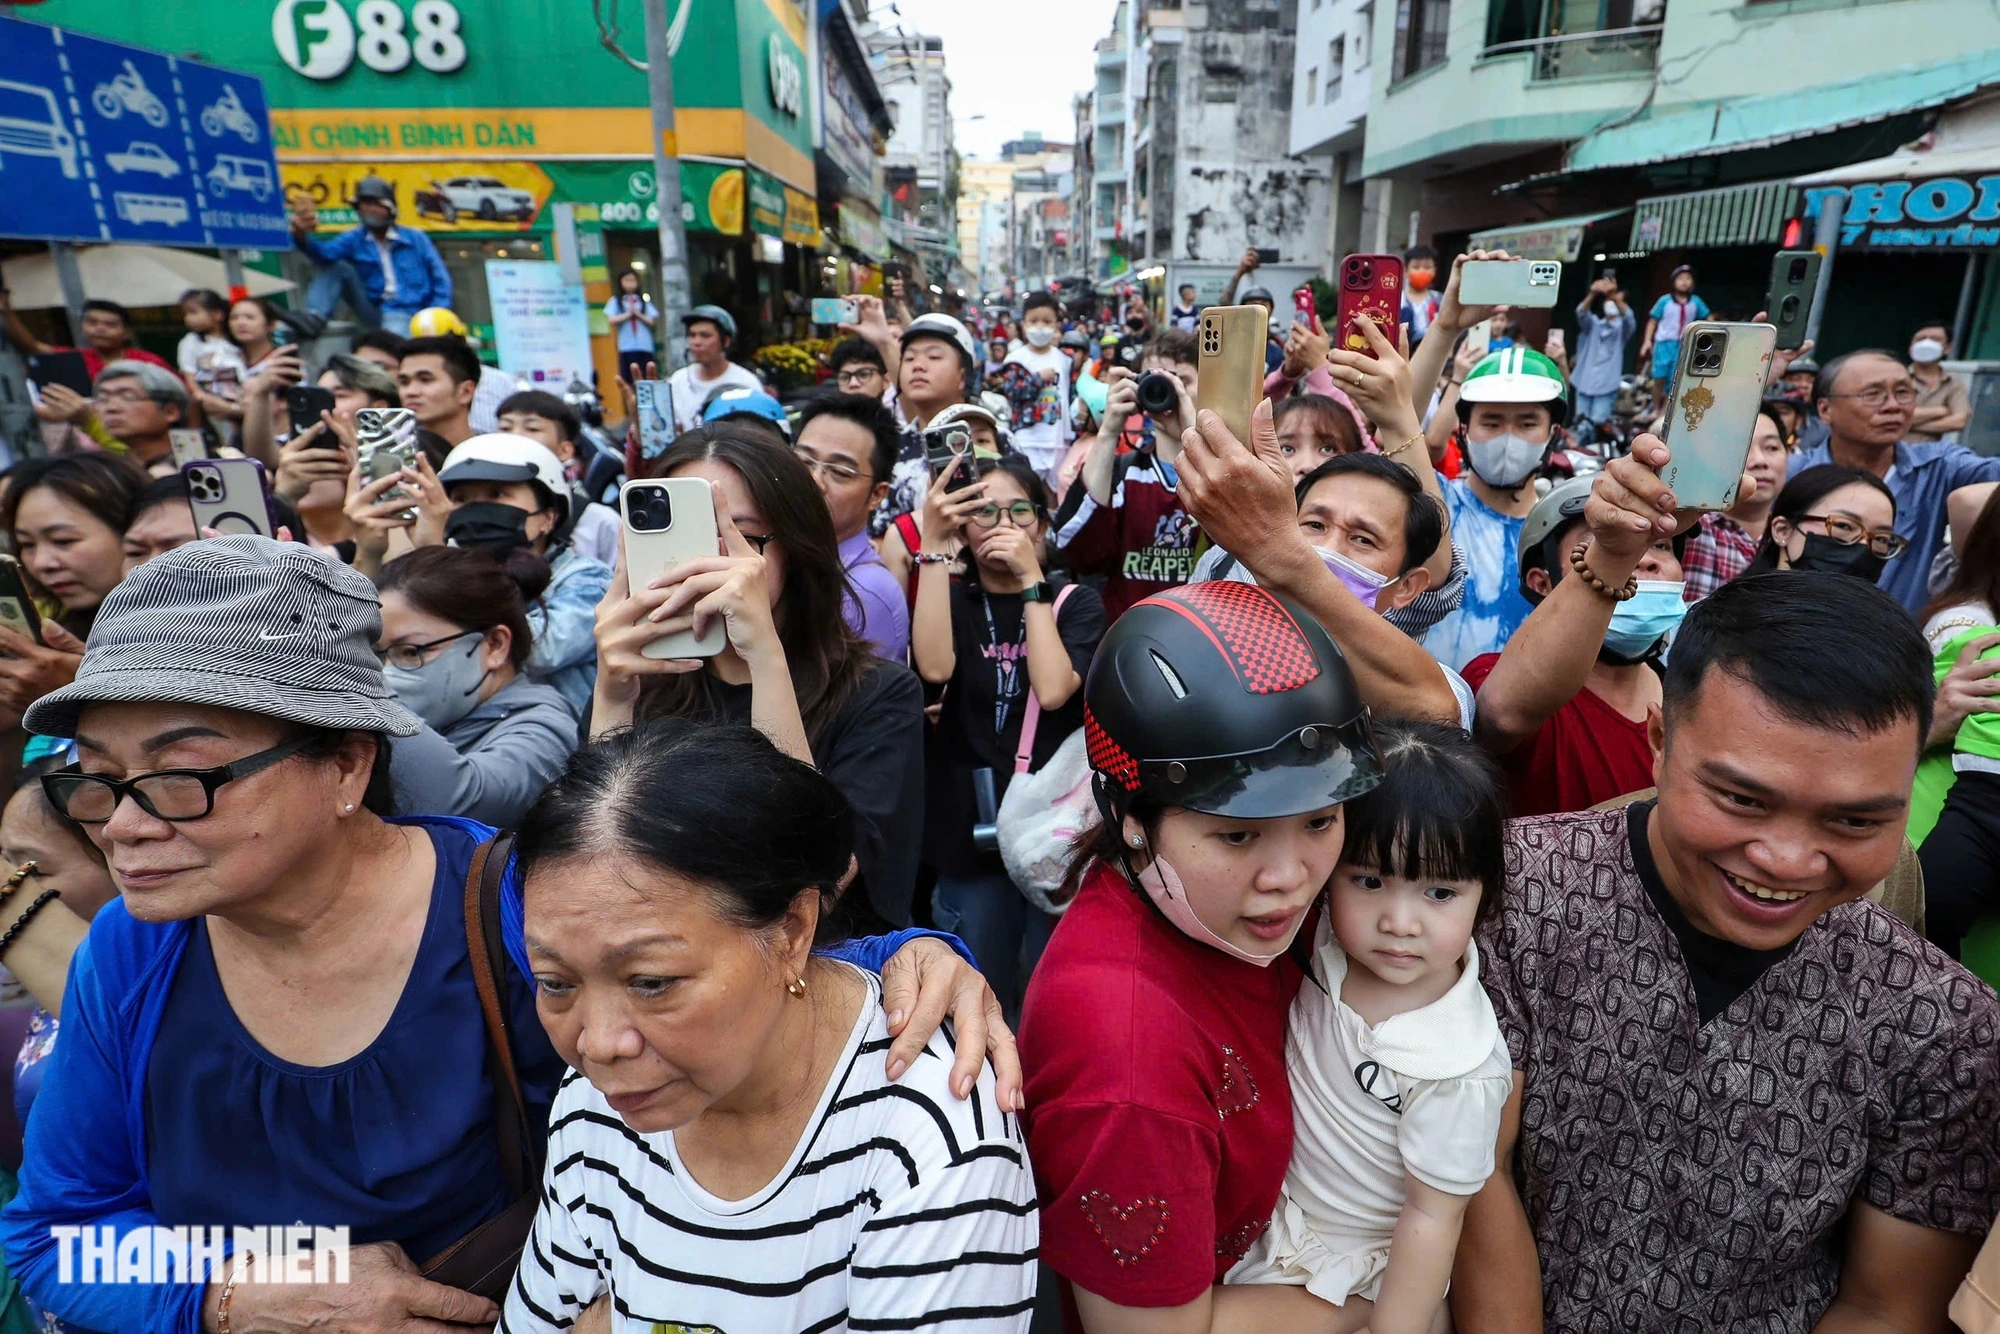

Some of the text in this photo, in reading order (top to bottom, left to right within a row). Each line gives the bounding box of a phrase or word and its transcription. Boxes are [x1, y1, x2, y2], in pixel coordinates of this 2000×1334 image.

[272, 0, 467, 79] F88
[646, 202, 695, 222] 68
[1141, 546, 1195, 558] LEONARD
